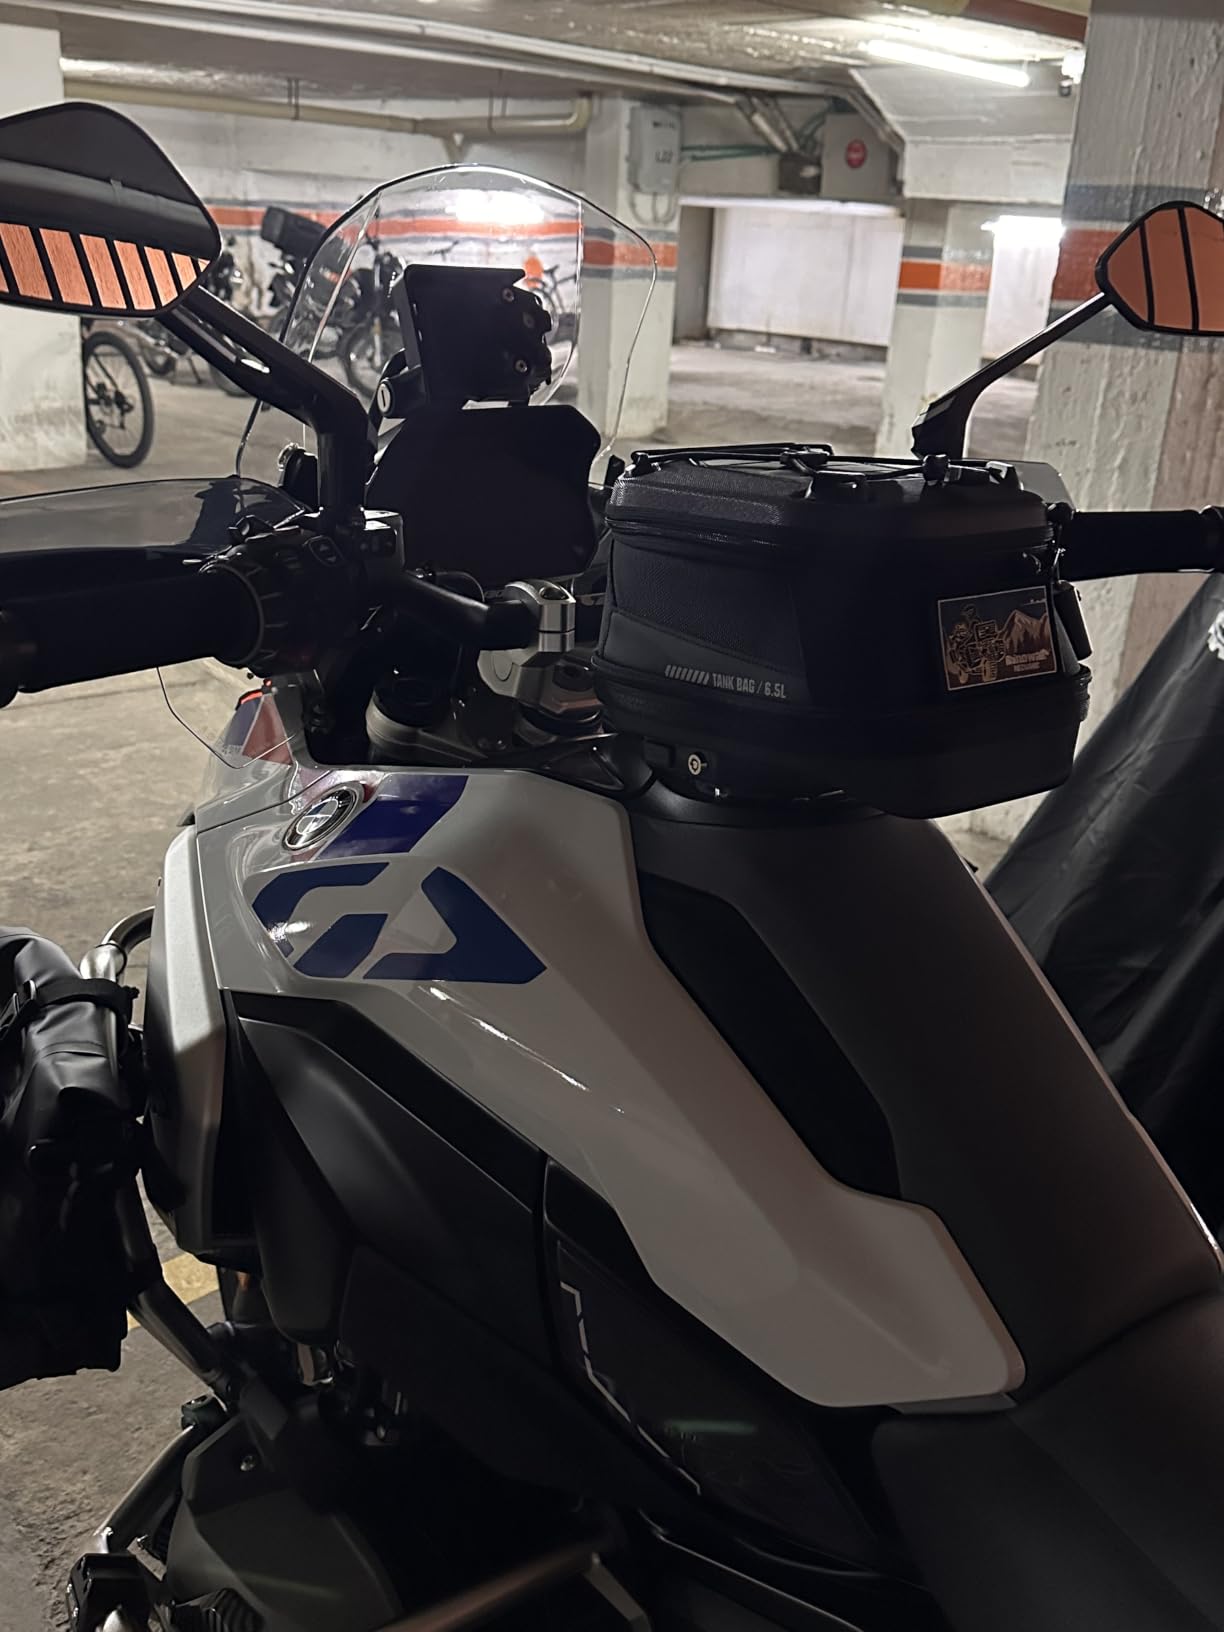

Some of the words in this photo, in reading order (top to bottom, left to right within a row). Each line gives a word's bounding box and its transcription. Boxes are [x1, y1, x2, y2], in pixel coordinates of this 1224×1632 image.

[712, 673, 734, 690] TANK
[736, 677, 755, 693] BAG
[764, 682, 786, 699] 6.5L
